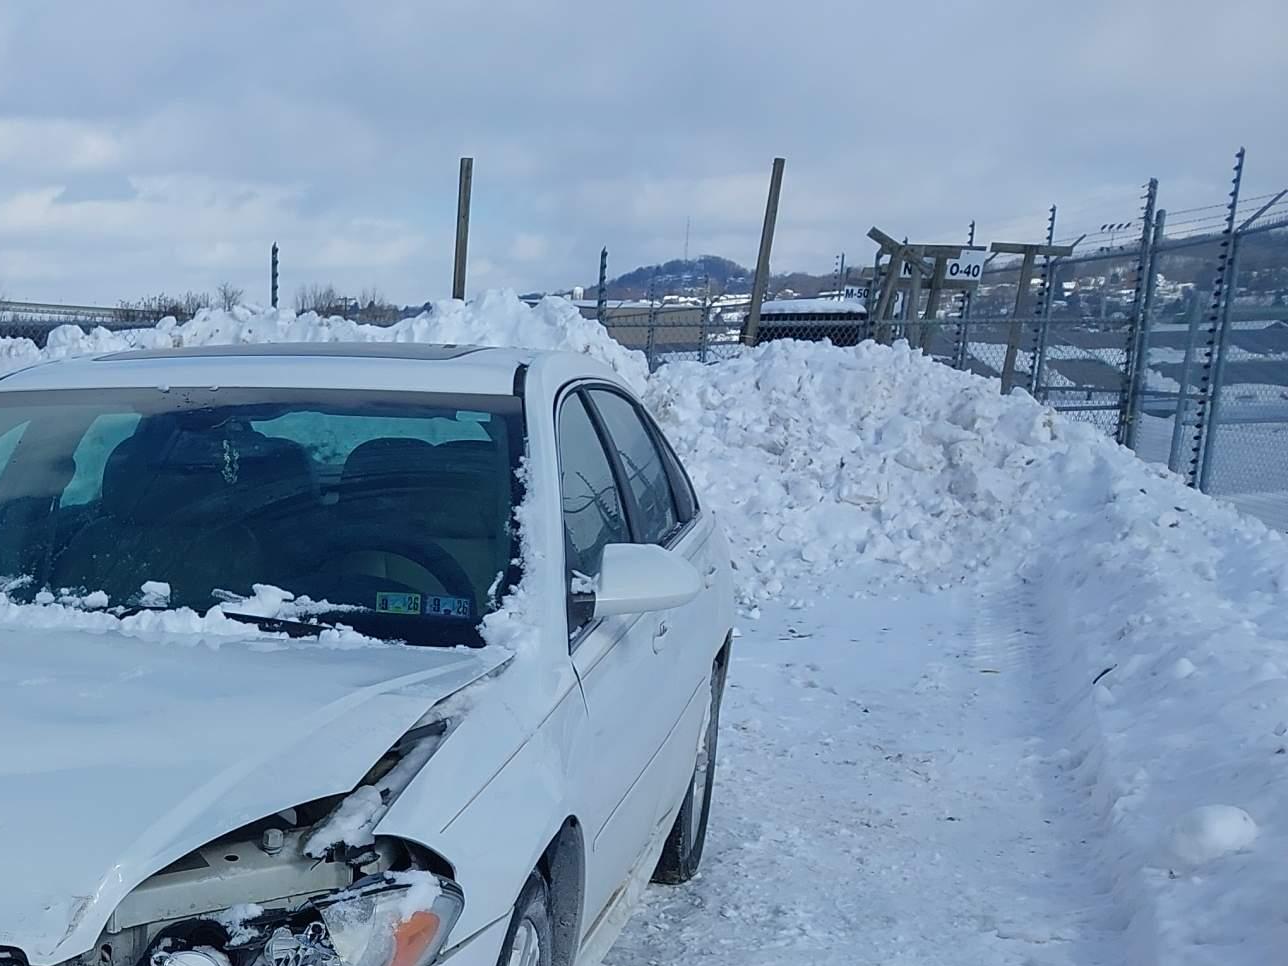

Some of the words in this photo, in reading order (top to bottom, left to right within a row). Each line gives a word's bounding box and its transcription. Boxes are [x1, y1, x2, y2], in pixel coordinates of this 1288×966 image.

[949, 262, 980, 278] O-40
[844, 288, 870, 299] M-50
[407, 596, 419, 611] 26
[456, 599, 468, 615] 26
